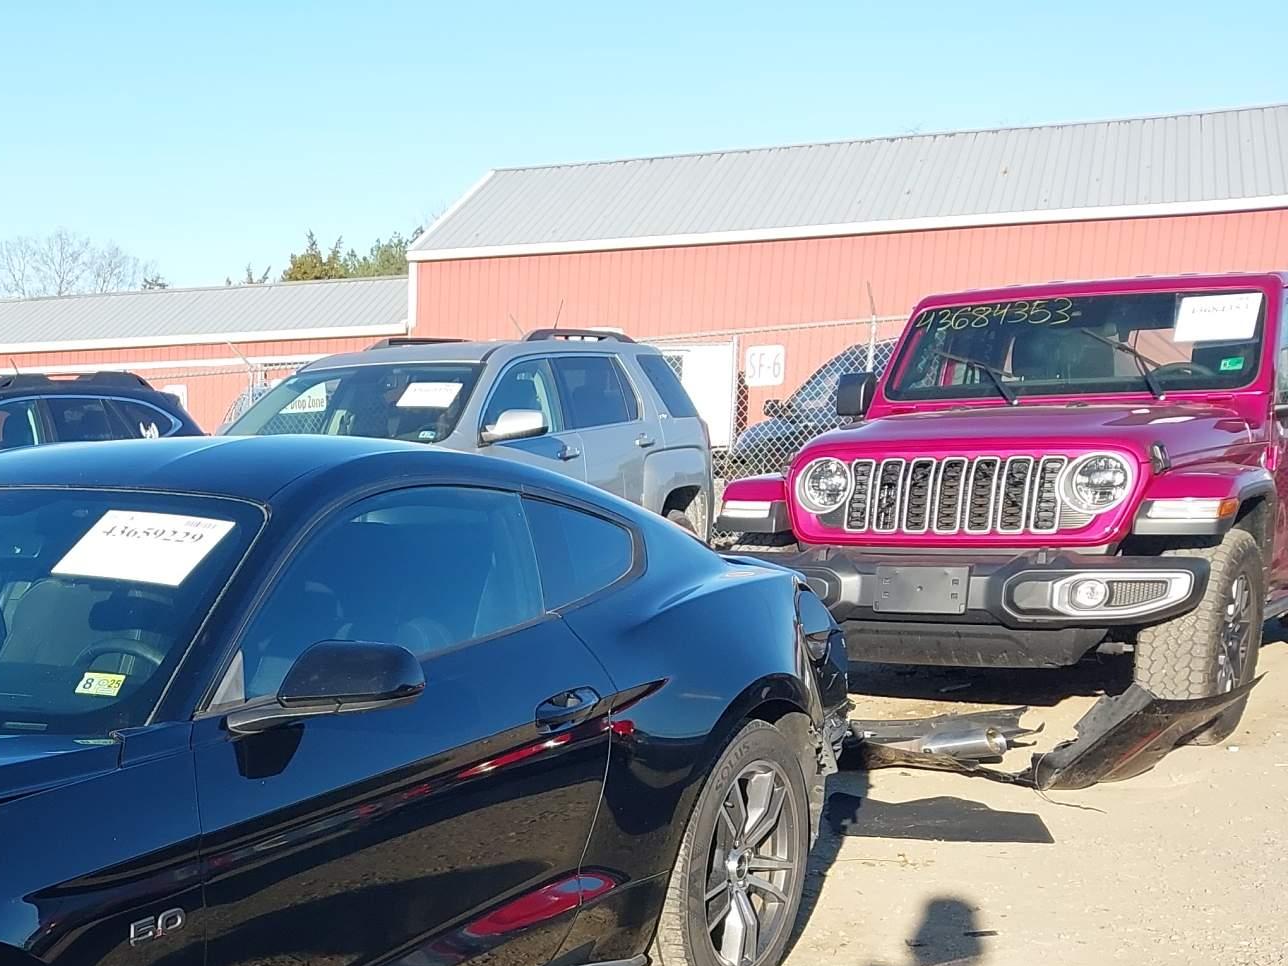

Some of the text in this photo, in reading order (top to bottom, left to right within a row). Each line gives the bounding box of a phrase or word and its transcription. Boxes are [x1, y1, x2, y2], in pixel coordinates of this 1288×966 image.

[915, 297, 1073, 333] 43684353
[748, 352, 782, 379] SF-6
[307, 395, 324, 408] Zone
[102, 524, 205, 544] 43659229
[83, 677, 122, 690] 8 25
